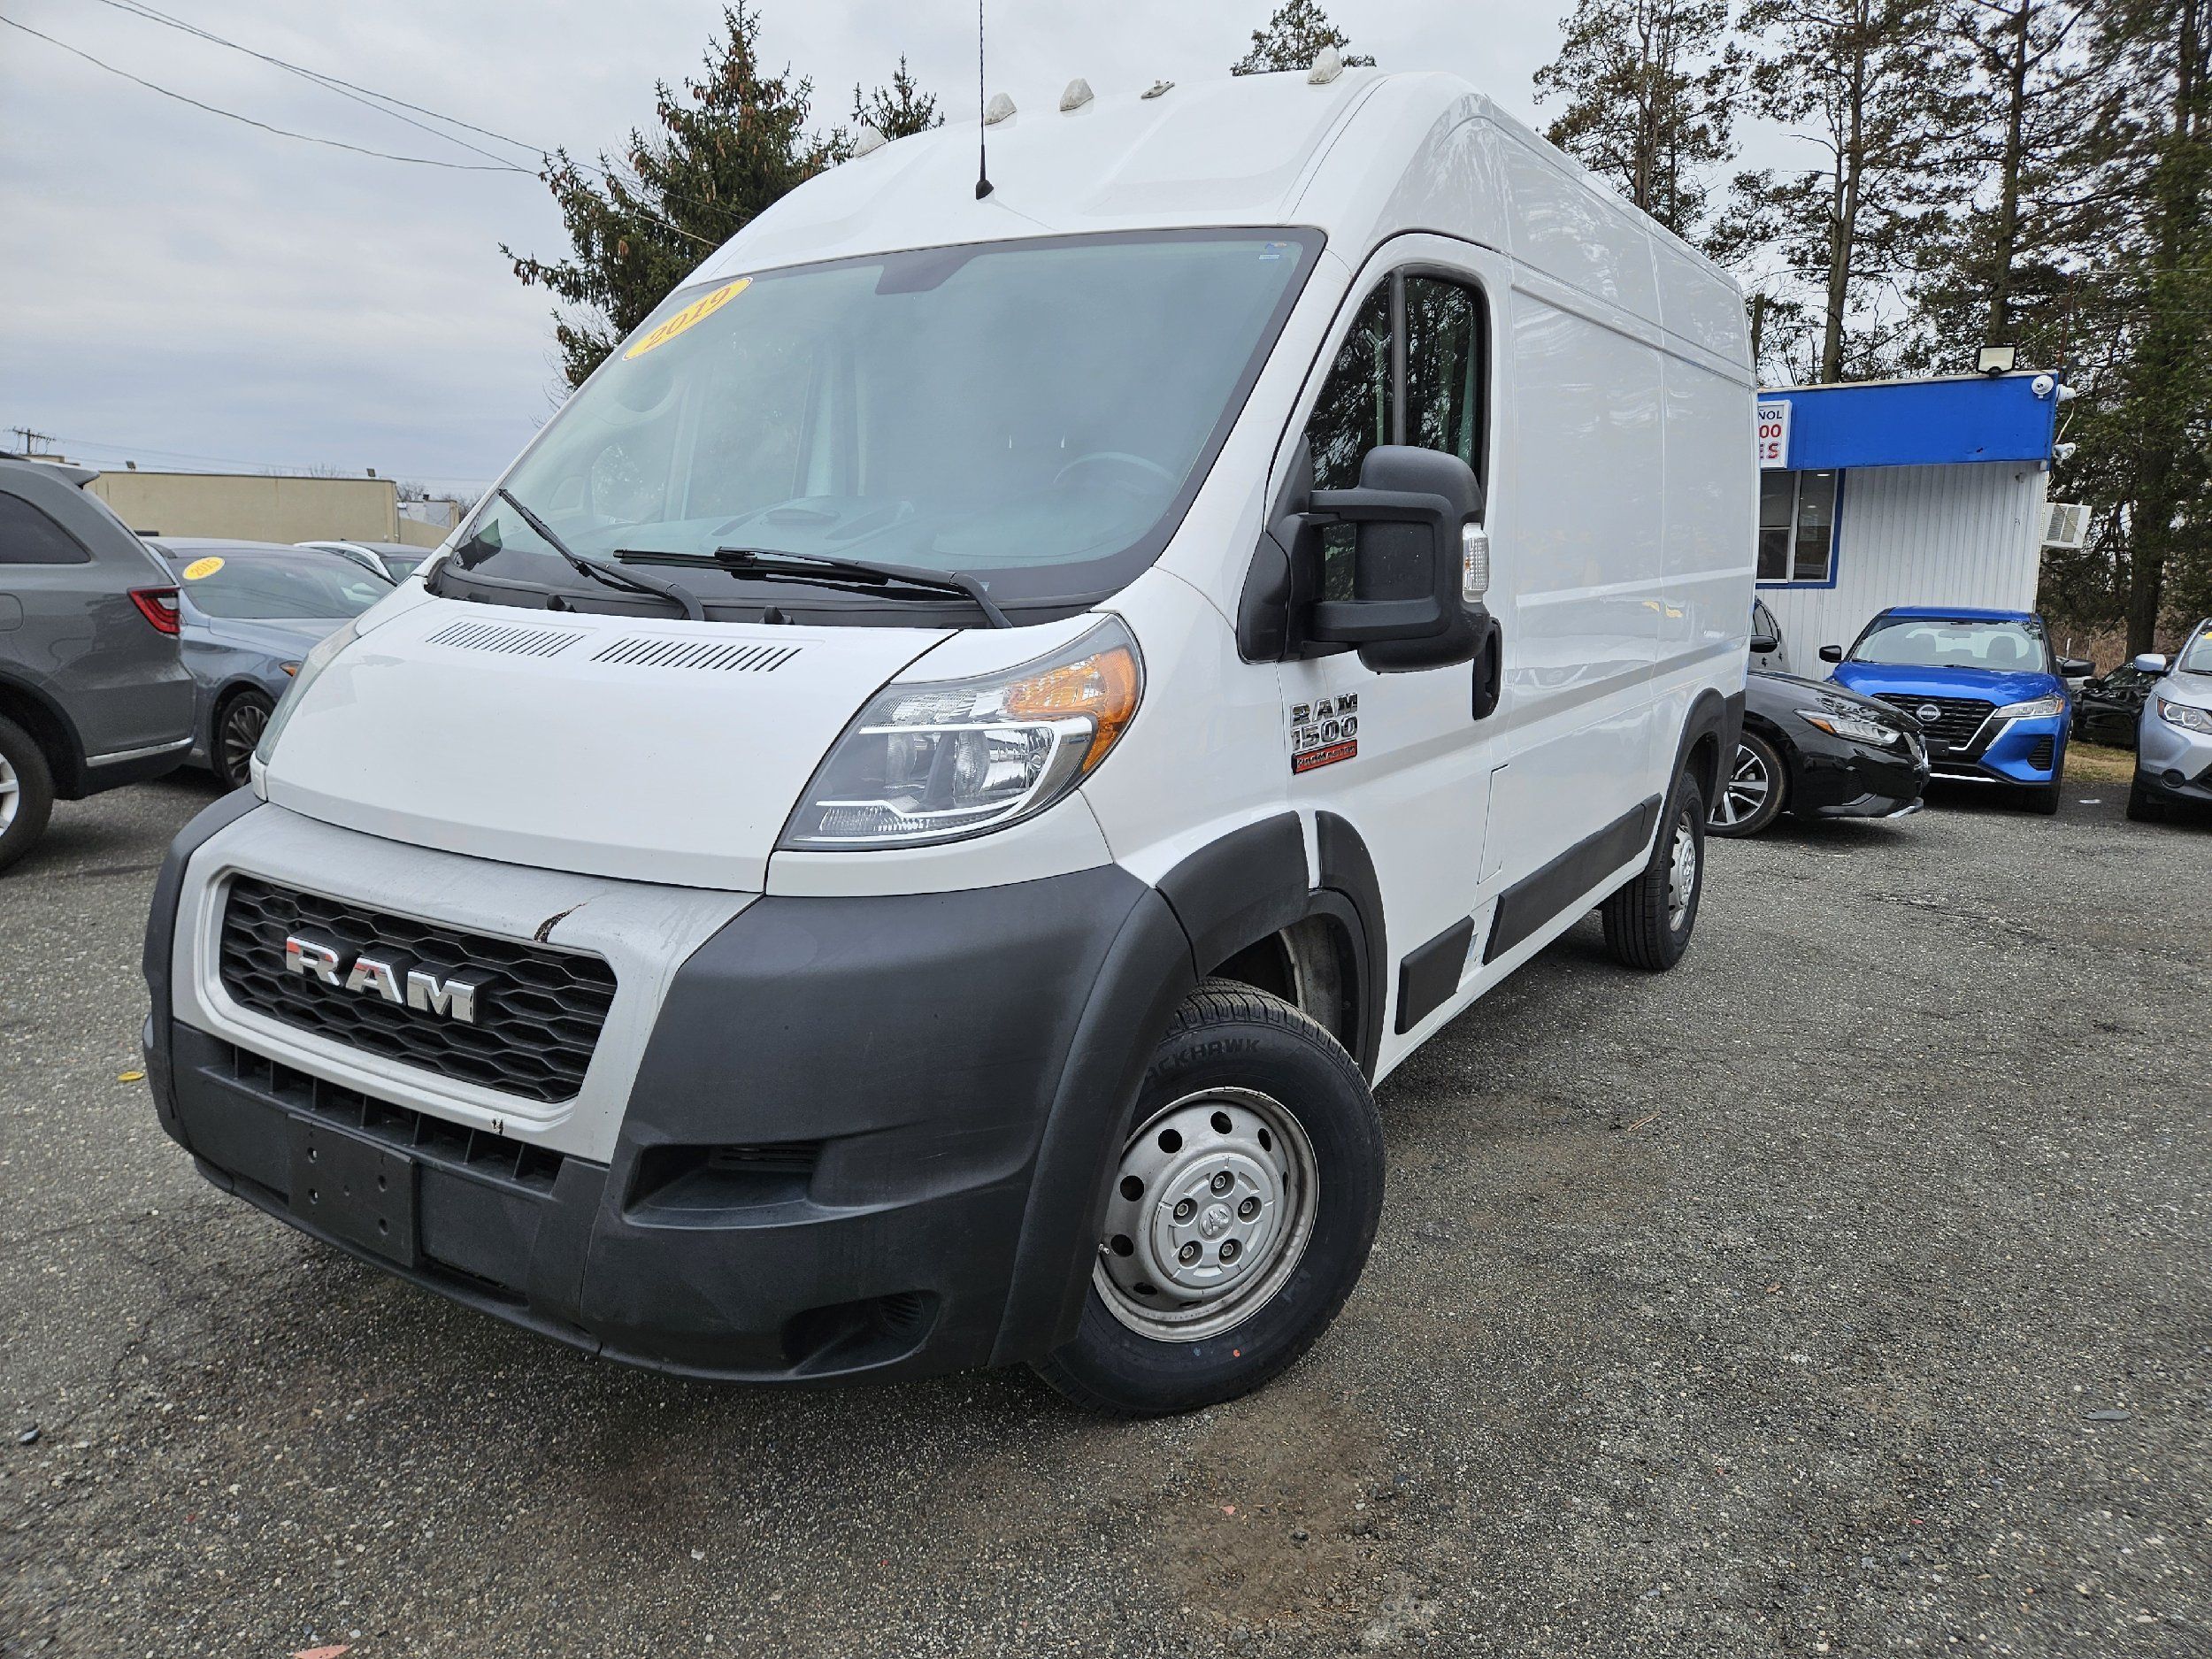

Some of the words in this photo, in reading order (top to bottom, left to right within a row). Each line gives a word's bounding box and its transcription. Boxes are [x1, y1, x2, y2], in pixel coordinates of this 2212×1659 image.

[644, 287, 732, 350] 2019
[1759, 424, 1782, 438] 00
[1290, 693, 1358, 726] RAM
[1291, 715, 1358, 751] 1500
[286, 936, 475, 1024] RAM
